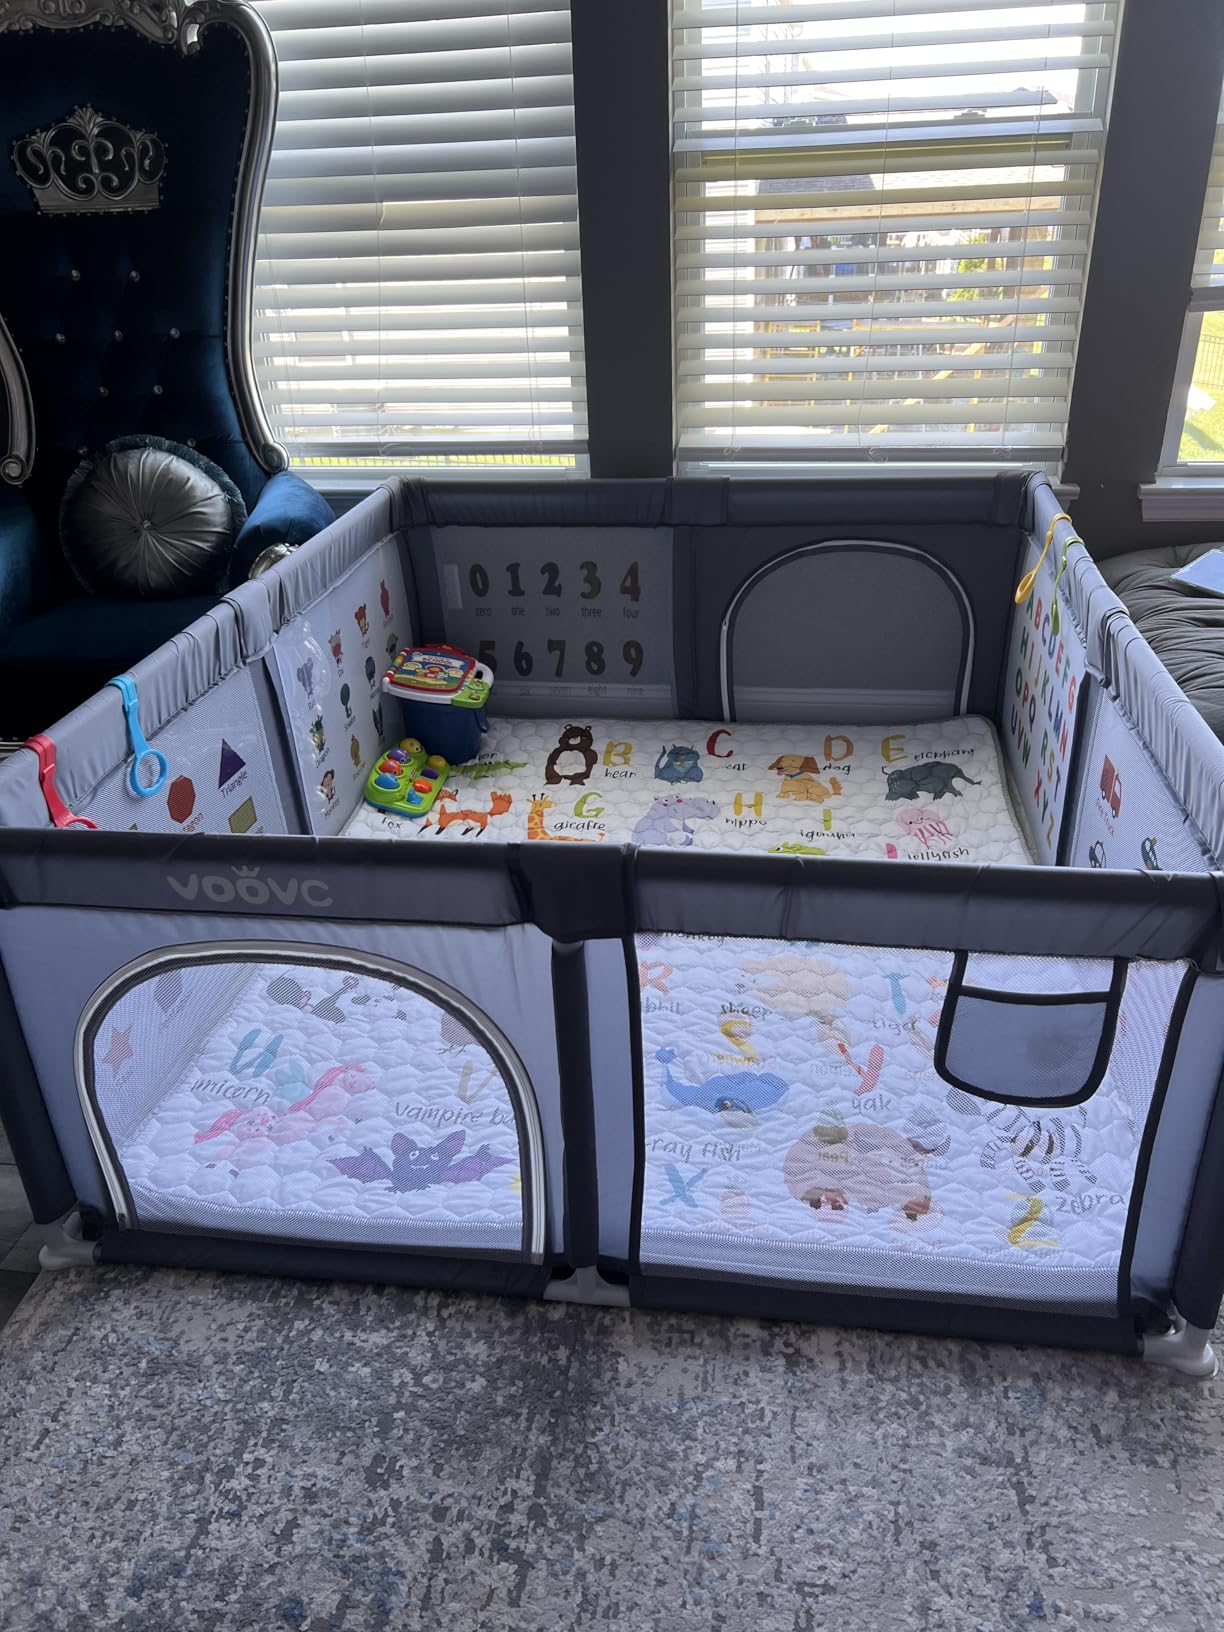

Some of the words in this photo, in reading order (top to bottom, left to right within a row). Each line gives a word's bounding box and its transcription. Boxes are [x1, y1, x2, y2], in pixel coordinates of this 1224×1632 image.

[469, 564, 489, 597] 0
[505, 562, 525, 596] 1
[540, 562, 562, 597] 2
[579, 561, 602, 599] 3
[619, 561, 641, 603] 4
[581, 606, 602, 617] three
[623, 607, 640, 618] four
[514, 641, 533, 676] 6
[547, 638, 566, 677] 7
[584, 641, 606, 675] 8
[622, 640, 643, 677] 9
[1026, 590, 1034, 620] A
[1035, 597, 1042, 630] B
[1042, 613, 1050, 647] C
[1056, 639, 1064, 678] E
[1062, 655, 1070, 688] F
[1068, 674, 1076, 713] G
[1020, 625, 1029, 659] H
[1034, 654, 1042, 688] J
[1041, 669, 1049, 707] K
[1048, 685, 1054, 722] L
[1053, 699, 1063, 744] M
[1060, 719, 1068, 762] N
[706, 730, 734, 757] C
[823, 735, 854, 761] D
[881, 734, 909, 763] E
[1015, 667, 1022, 698] O
[1022, 681, 1029, 708] P
[1029, 694, 1036, 733] Q
[1041, 728, 1048, 766] R
[1047, 749, 1055, 783] S
[1054, 765, 1061, 802] T
[603, 741, 632, 766] B
[1011, 703, 1018, 736] U
[1017, 719, 1024, 750] V
[1022, 731, 1031, 769] W
[1034, 767, 1042, 808] X
[1042, 788, 1049, 825] Y
[822, 763, 850, 775] dog
[220, 770, 249, 797] Triangle
[573, 792, 605, 818] G
[734, 792, 763, 817] H
[553, 820, 606, 833] giraffe
[639, 960, 672, 999] R
[229, 1028, 283, 1078] U
[719, 1019, 758, 1065] S
[456, 1059, 498, 1104] V
[837, 1042, 885, 1097] Y
[190, 1079, 271, 1105] unicorn
[851, 1094, 891, 1113] yak
[394, 1102, 483, 1128] vampire
[646, 1138, 692, 1164] -ray
[702, 1142, 741, 1163] fish
[660, 1163, 707, 1209] X
[1055, 1190, 1125, 1217] zebra
[1006, 1192, 1059, 1247] Z
